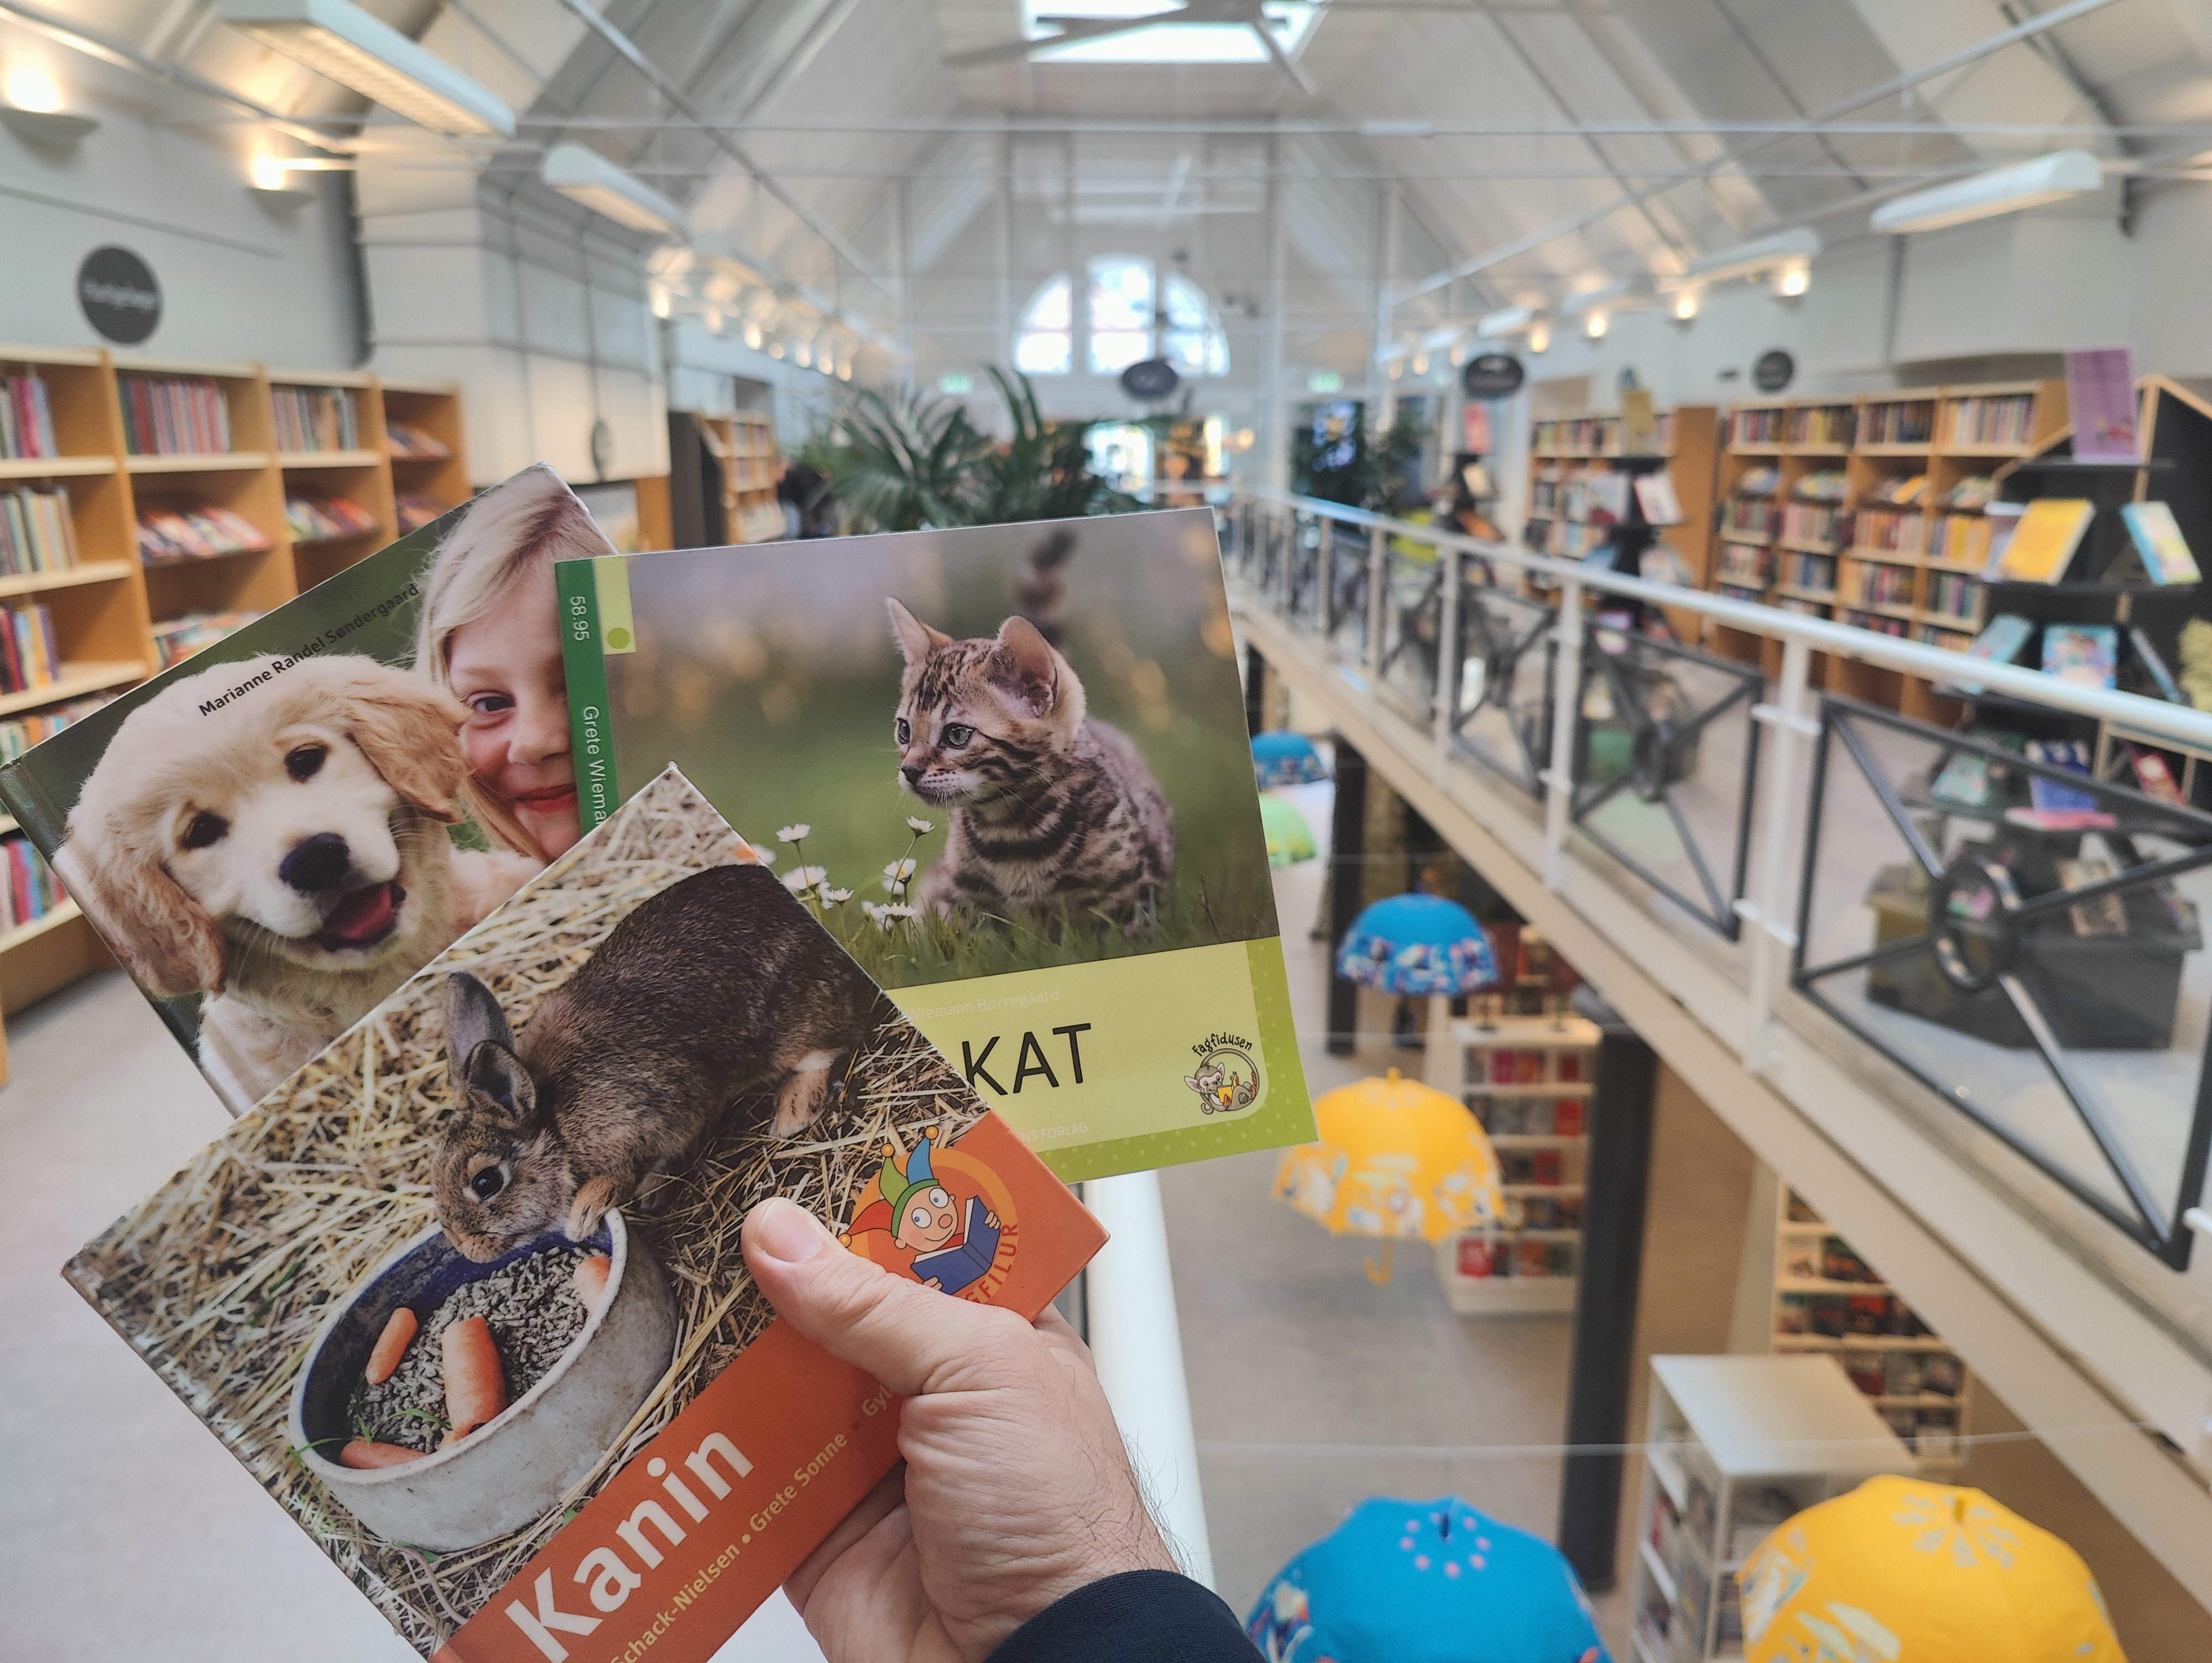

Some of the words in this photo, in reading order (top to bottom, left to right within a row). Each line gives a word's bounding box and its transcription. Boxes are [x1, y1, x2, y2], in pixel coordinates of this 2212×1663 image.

[570, 595, 589, 641] 58.95
[199, 670, 273, 716] Marianne
[272, 637, 325, 673] Randel
[325, 583, 419, 643] Søndergaard
[583, 706, 600, 755] Grete
[978, 989, 1060, 1009] Borregaard
[962, 1023, 1091, 1095] KAT
[1041, 1122, 1088, 1139] FORLAG
[749, 1482, 797, 1532] Grete
[794, 1432, 848, 1486] Sonne
[504, 1432, 754, 1663] Kanin
